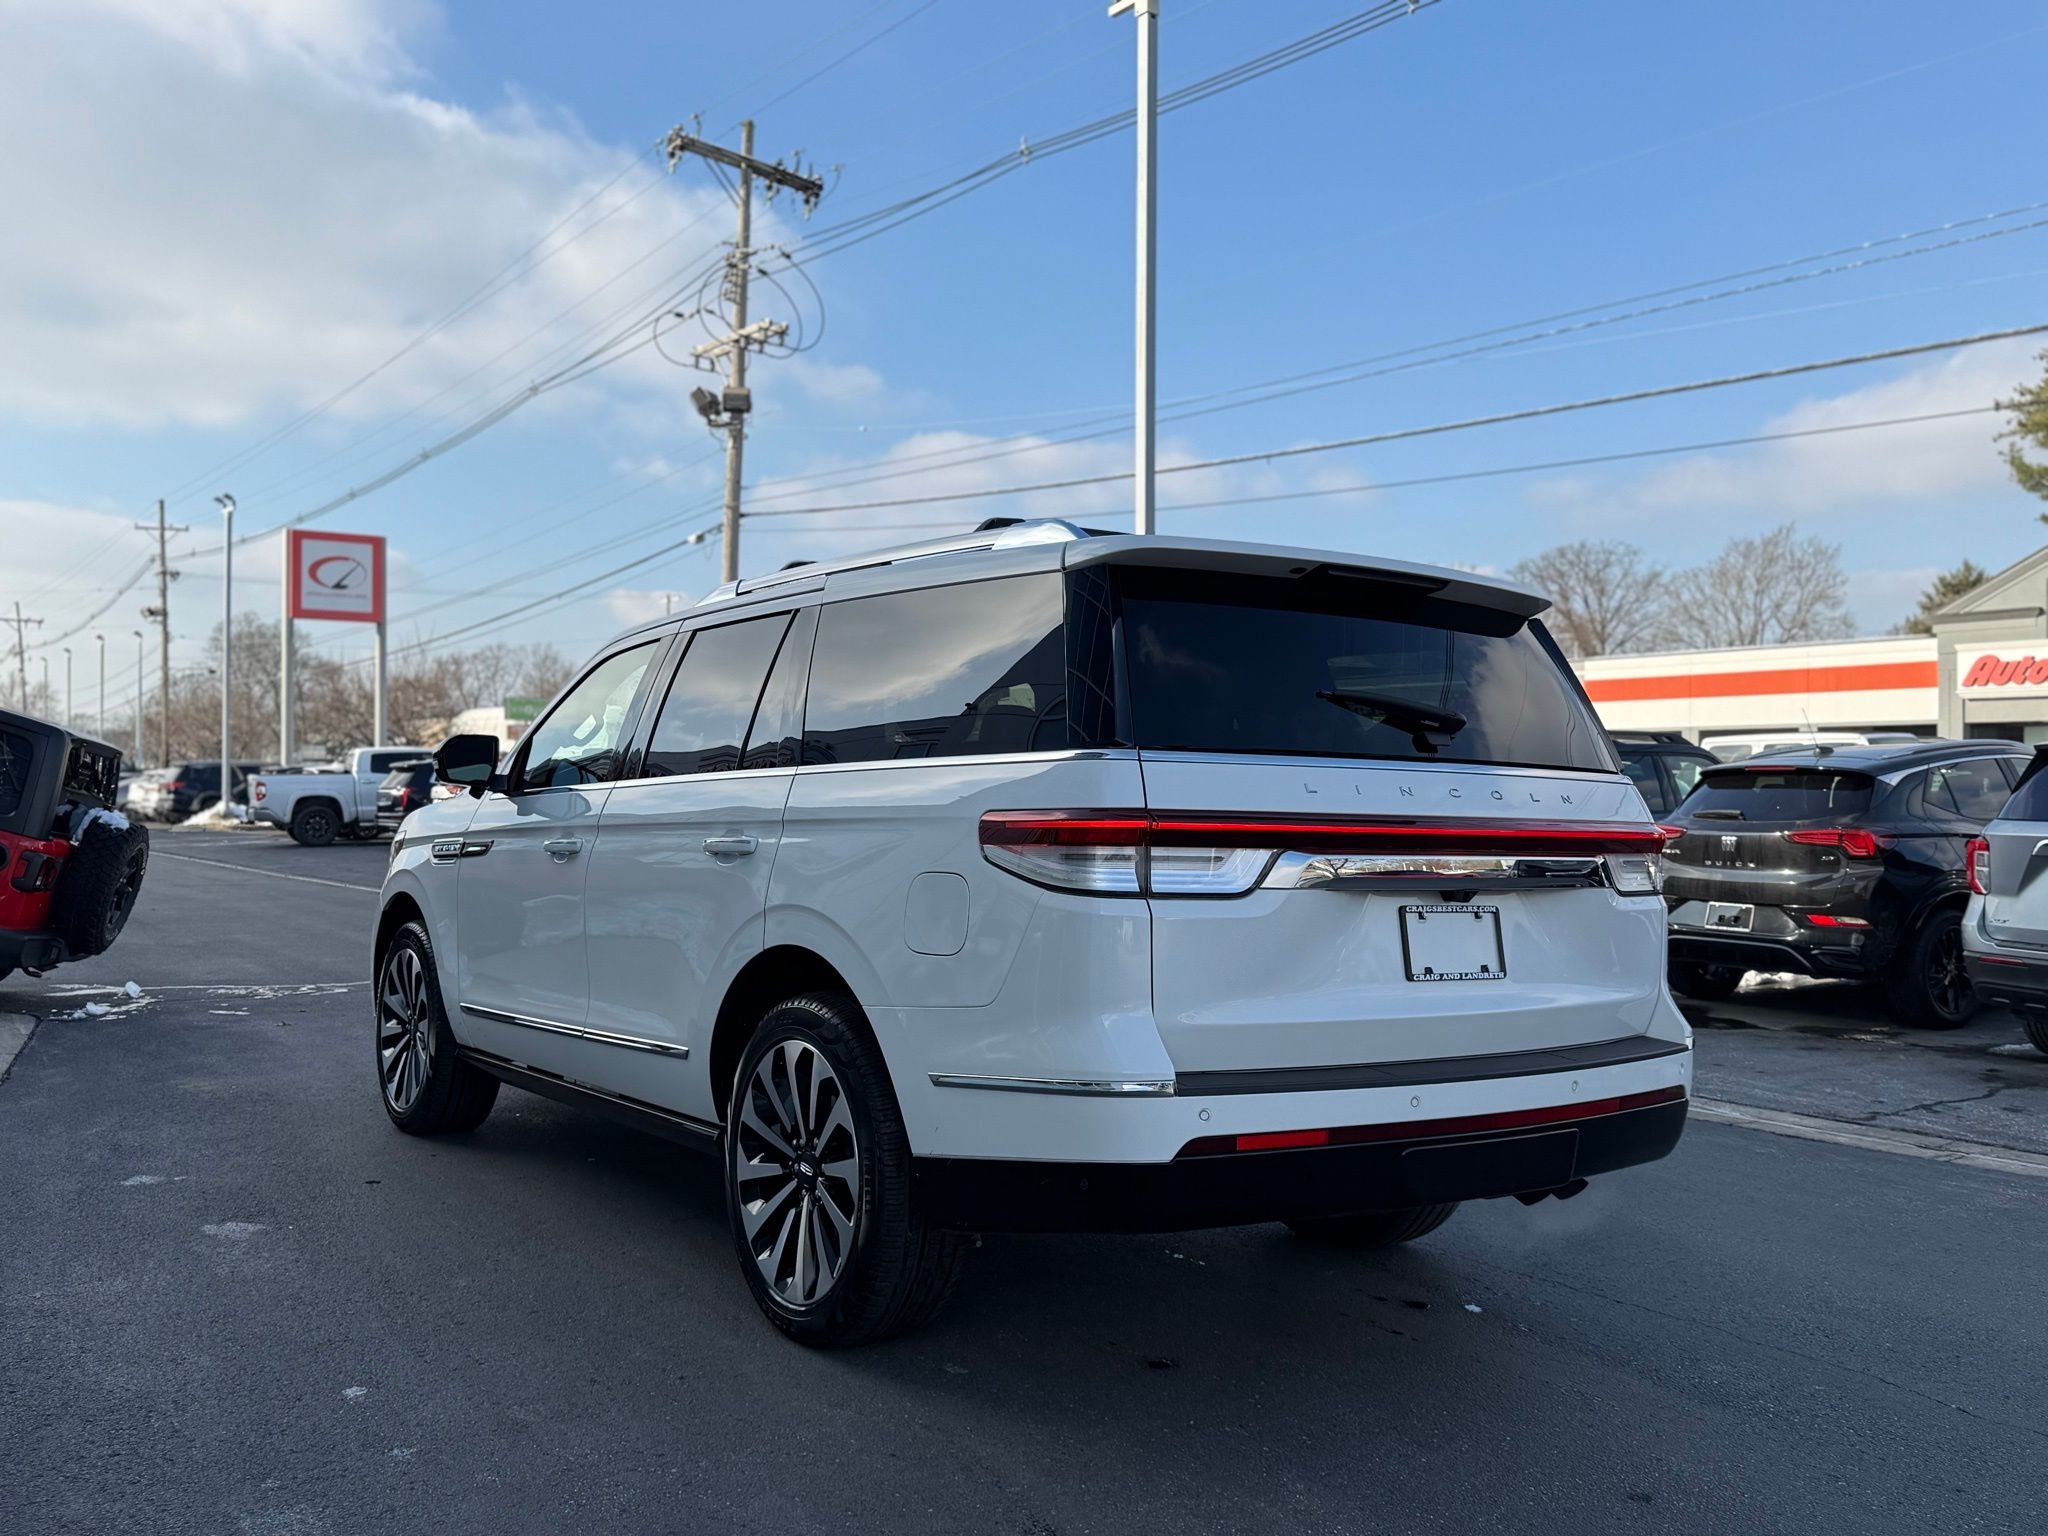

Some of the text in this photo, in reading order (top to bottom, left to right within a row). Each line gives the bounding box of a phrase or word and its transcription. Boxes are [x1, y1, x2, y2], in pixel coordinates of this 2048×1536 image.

[1304, 782, 1574, 805] LINCOLN
[1704, 860, 1756, 868] BUICK
[1406, 905, 1497, 913] CRAIGSBESTCARS.COM
[1462, 972, 1504, 980] LANDRETH
